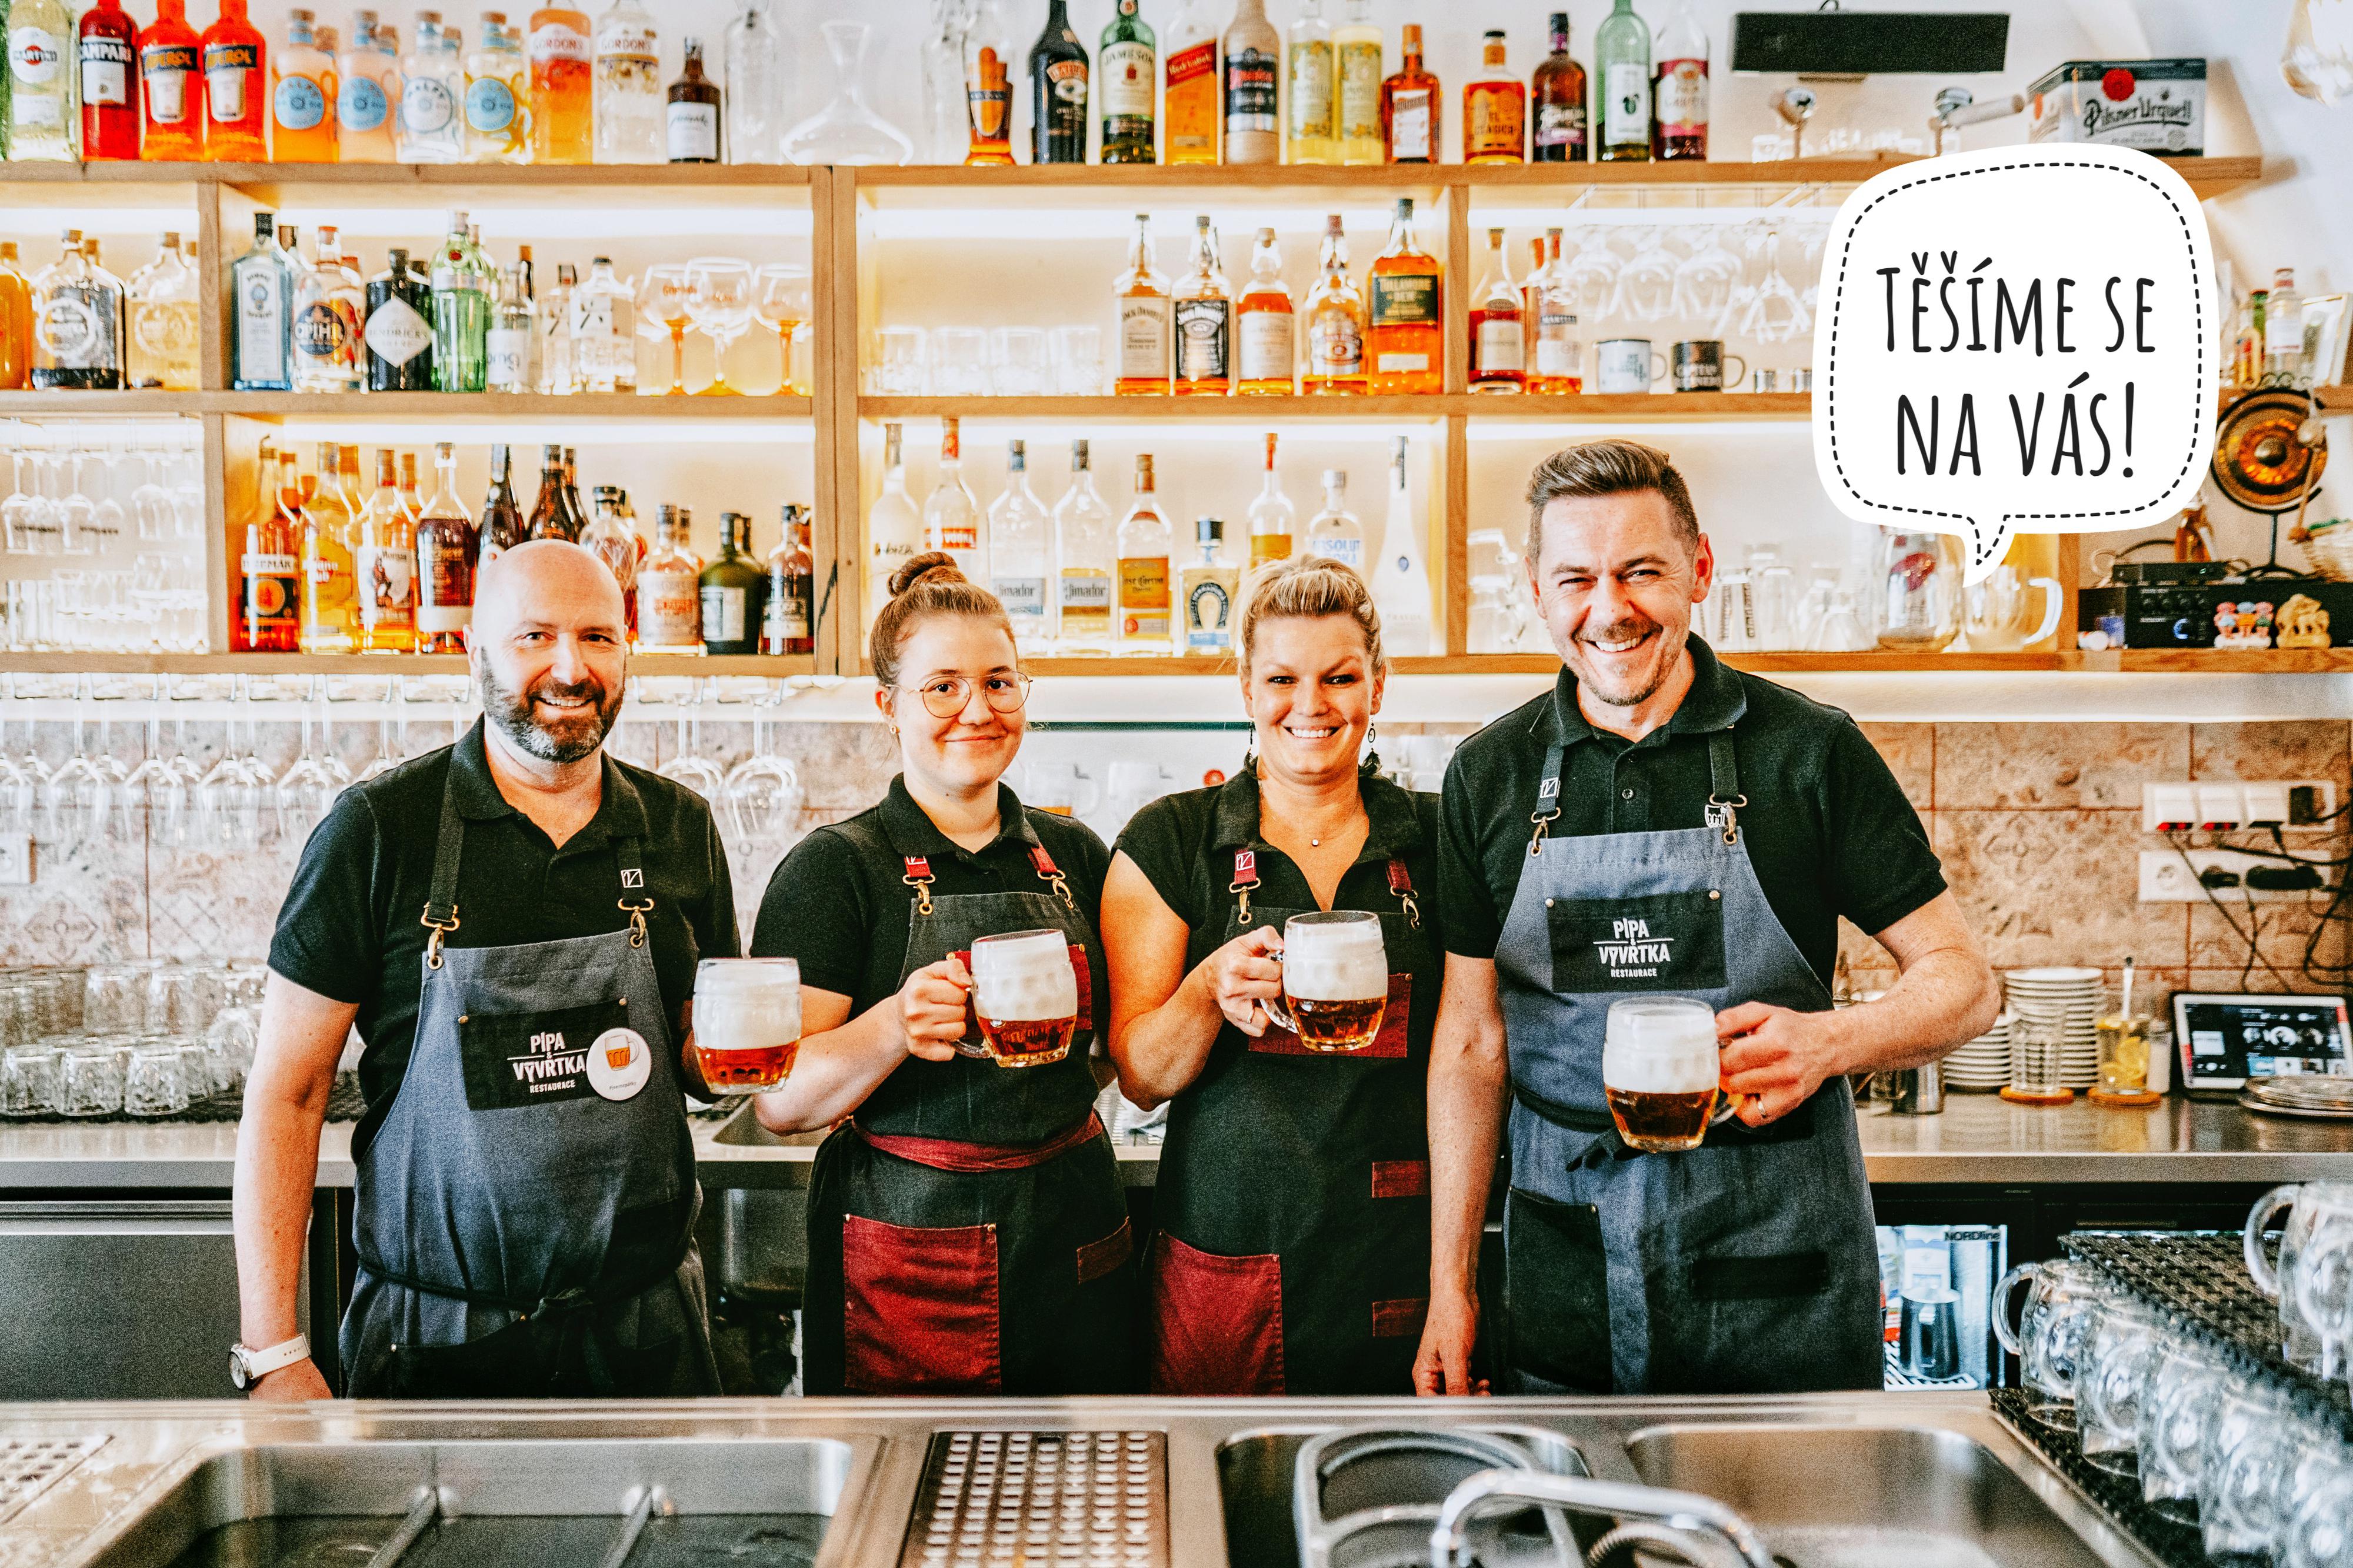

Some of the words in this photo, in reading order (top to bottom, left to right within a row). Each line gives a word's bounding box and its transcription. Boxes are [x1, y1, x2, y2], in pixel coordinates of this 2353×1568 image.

[1611, 968, 1658, 978] RESTAURACE
[529, 1079, 576, 1093] RESTAURACE
[1945, 1231, 2000, 1241] NORDline
